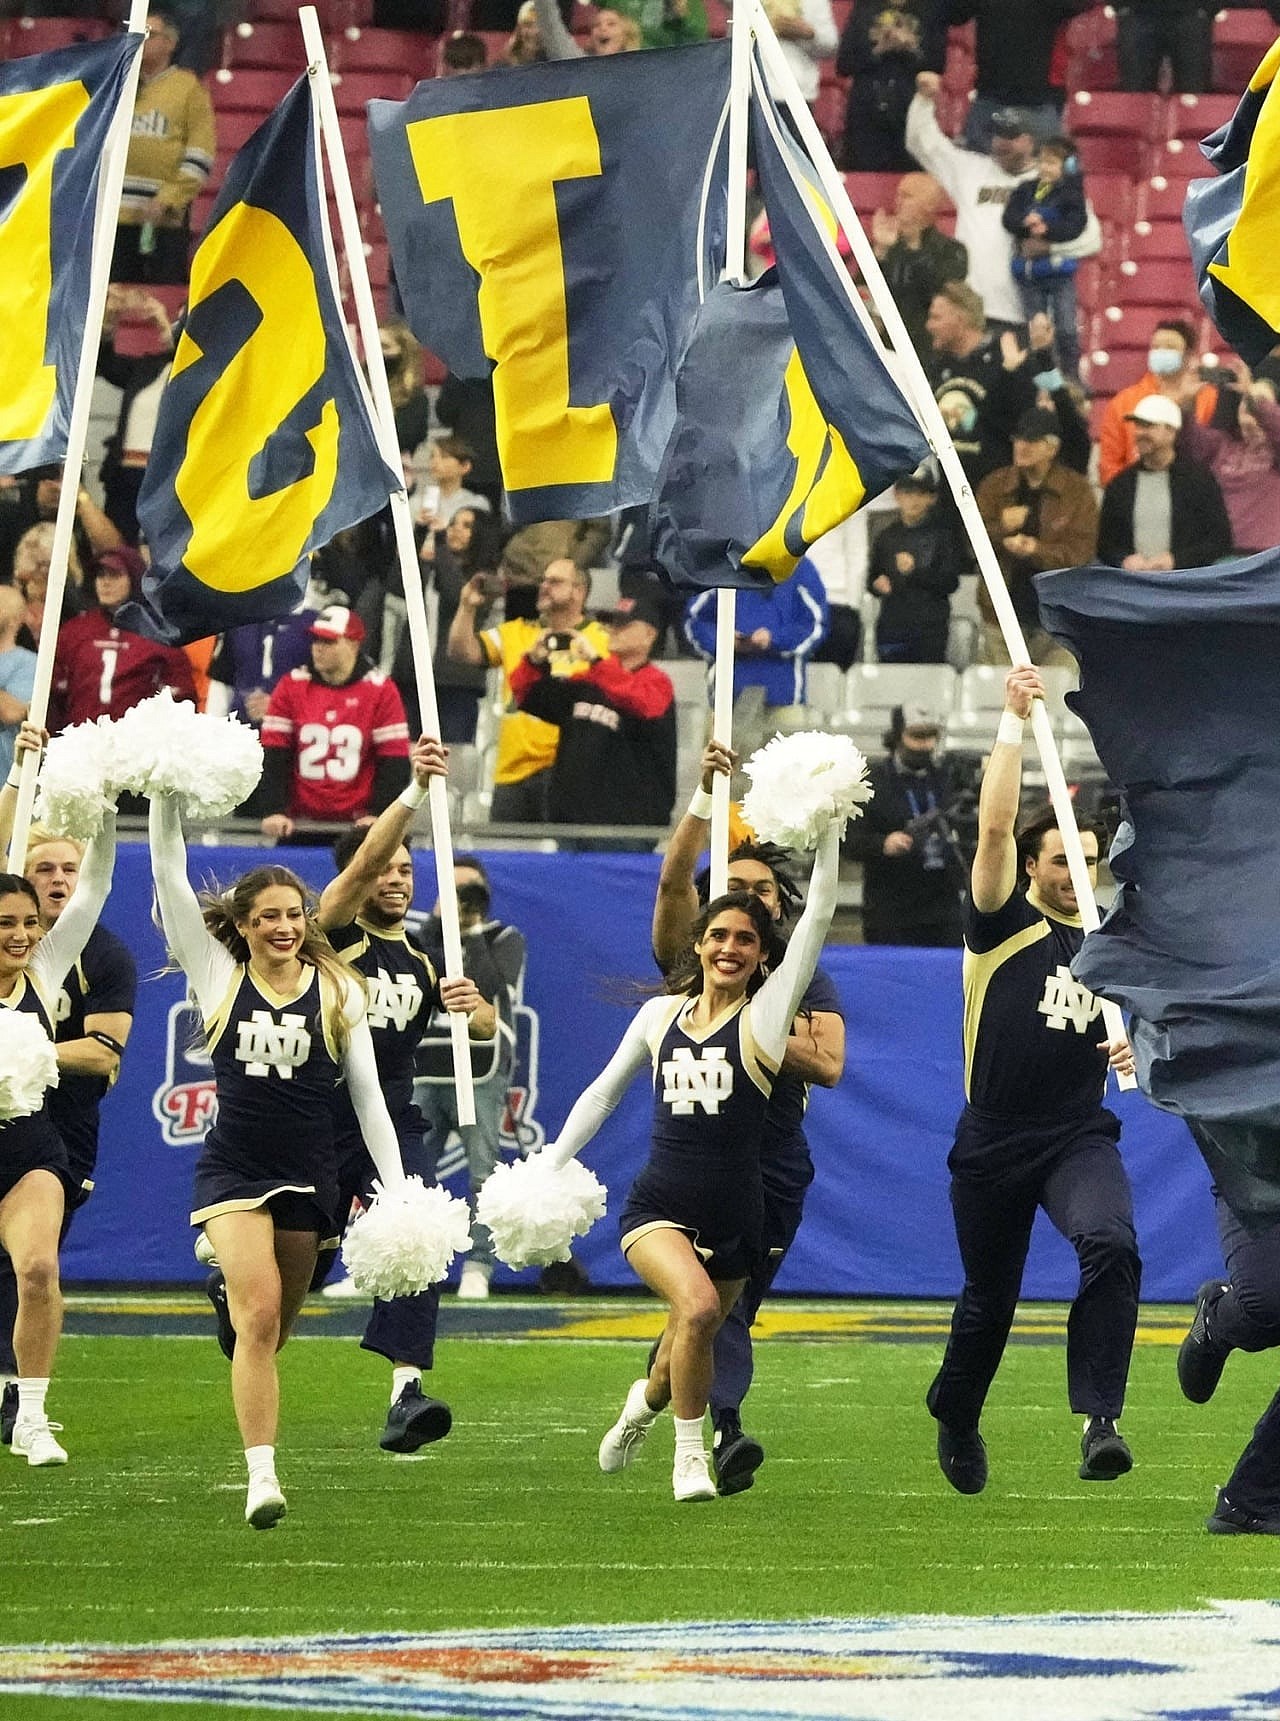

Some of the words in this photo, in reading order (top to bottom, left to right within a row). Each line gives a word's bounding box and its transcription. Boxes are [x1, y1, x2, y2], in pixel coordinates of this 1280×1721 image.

[100, 649, 118, 705] 1
[261, 634, 275, 678] 1
[299, 723, 363, 781] 23
[234, 1009, 312, 1081] ND
[661, 1046, 735, 1116] ND
